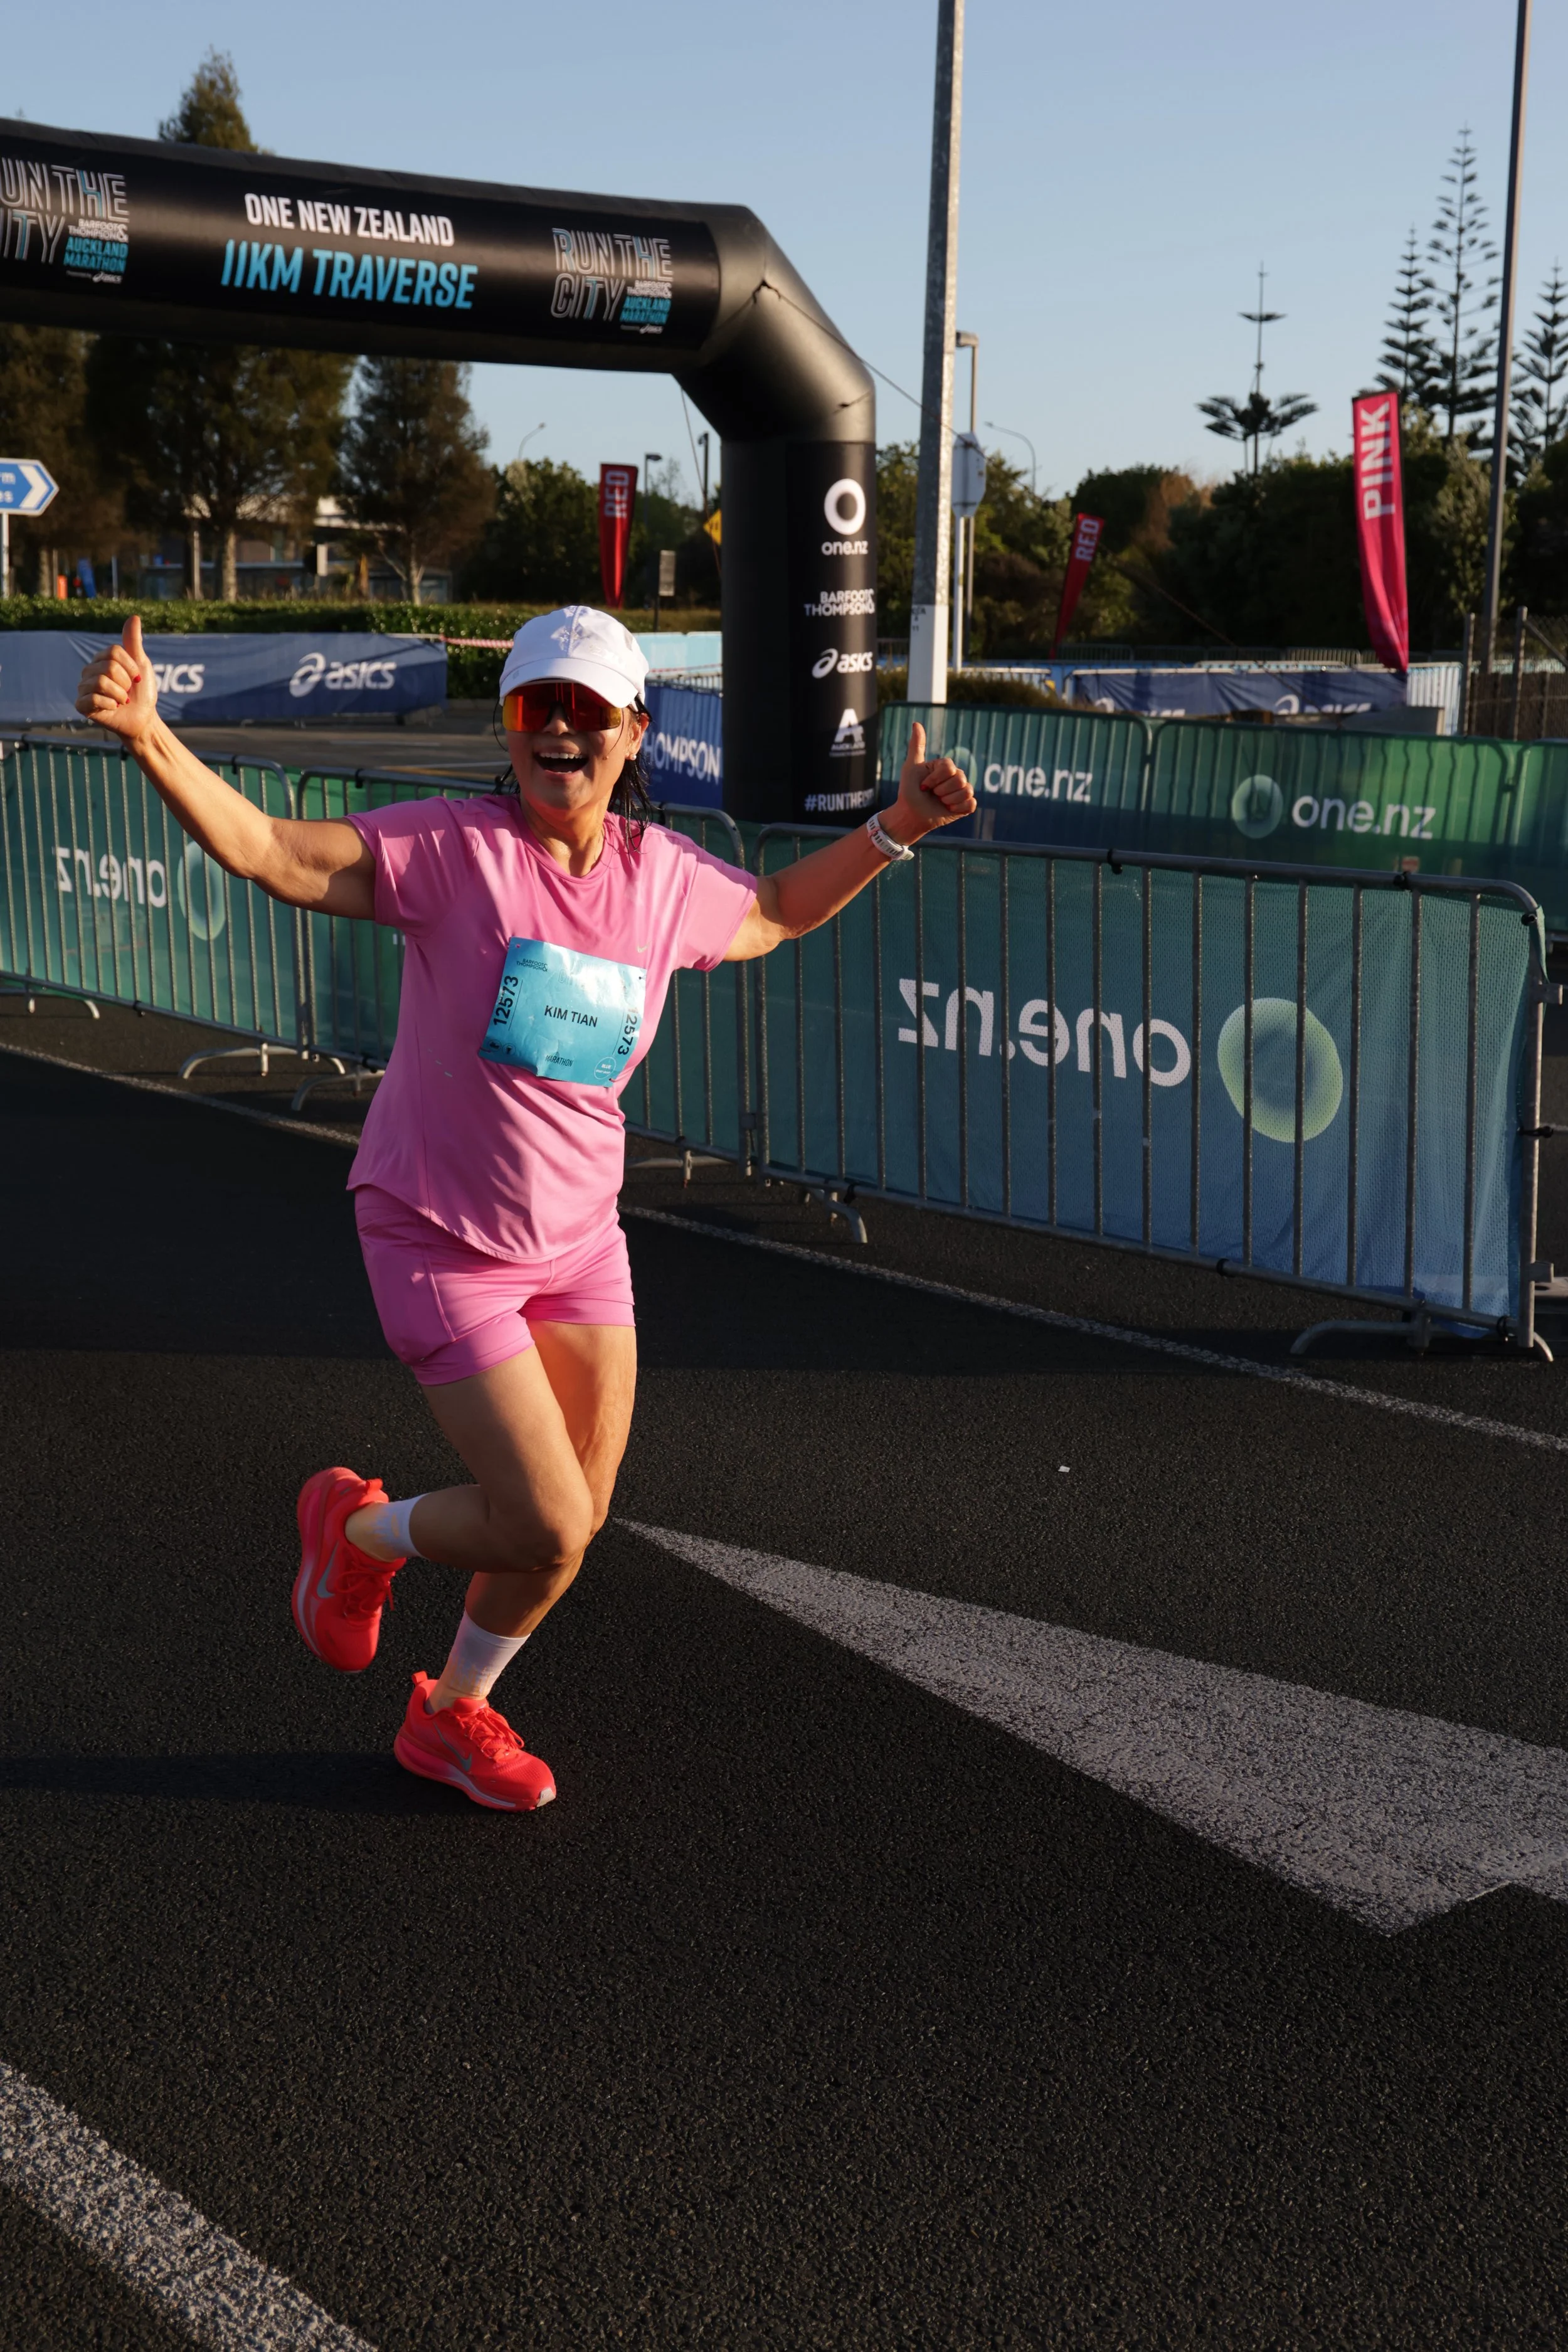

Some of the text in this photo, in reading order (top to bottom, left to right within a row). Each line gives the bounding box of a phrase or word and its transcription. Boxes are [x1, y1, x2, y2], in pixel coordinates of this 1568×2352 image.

[0, 157, 130, 223] UN THE
[0, 207, 66, 265] ITY
[245, 193, 455, 247] ONE NEW ZEALAND
[312, 248, 479, 309] TRAVERSE
[552, 228, 674, 282] RUN THE
[551, 273, 627, 322] CITY
[1360, 401, 1396, 520] PINK
[604, 470, 630, 518] RED
[821, 540, 869, 556] one.nz
[1074, 517, 1100, 561] RED
[152, 664, 205, 693] sics
[642, 731, 721, 785] HOMPSON
[983, 763, 1093, 803] one.nz
[1292, 795, 1436, 839] one.nz
[493, 975, 519, 1025] 12573
[544, 1005, 598, 1028] KIM TIAN
[545, 1054, 574, 1067] MARATHON
